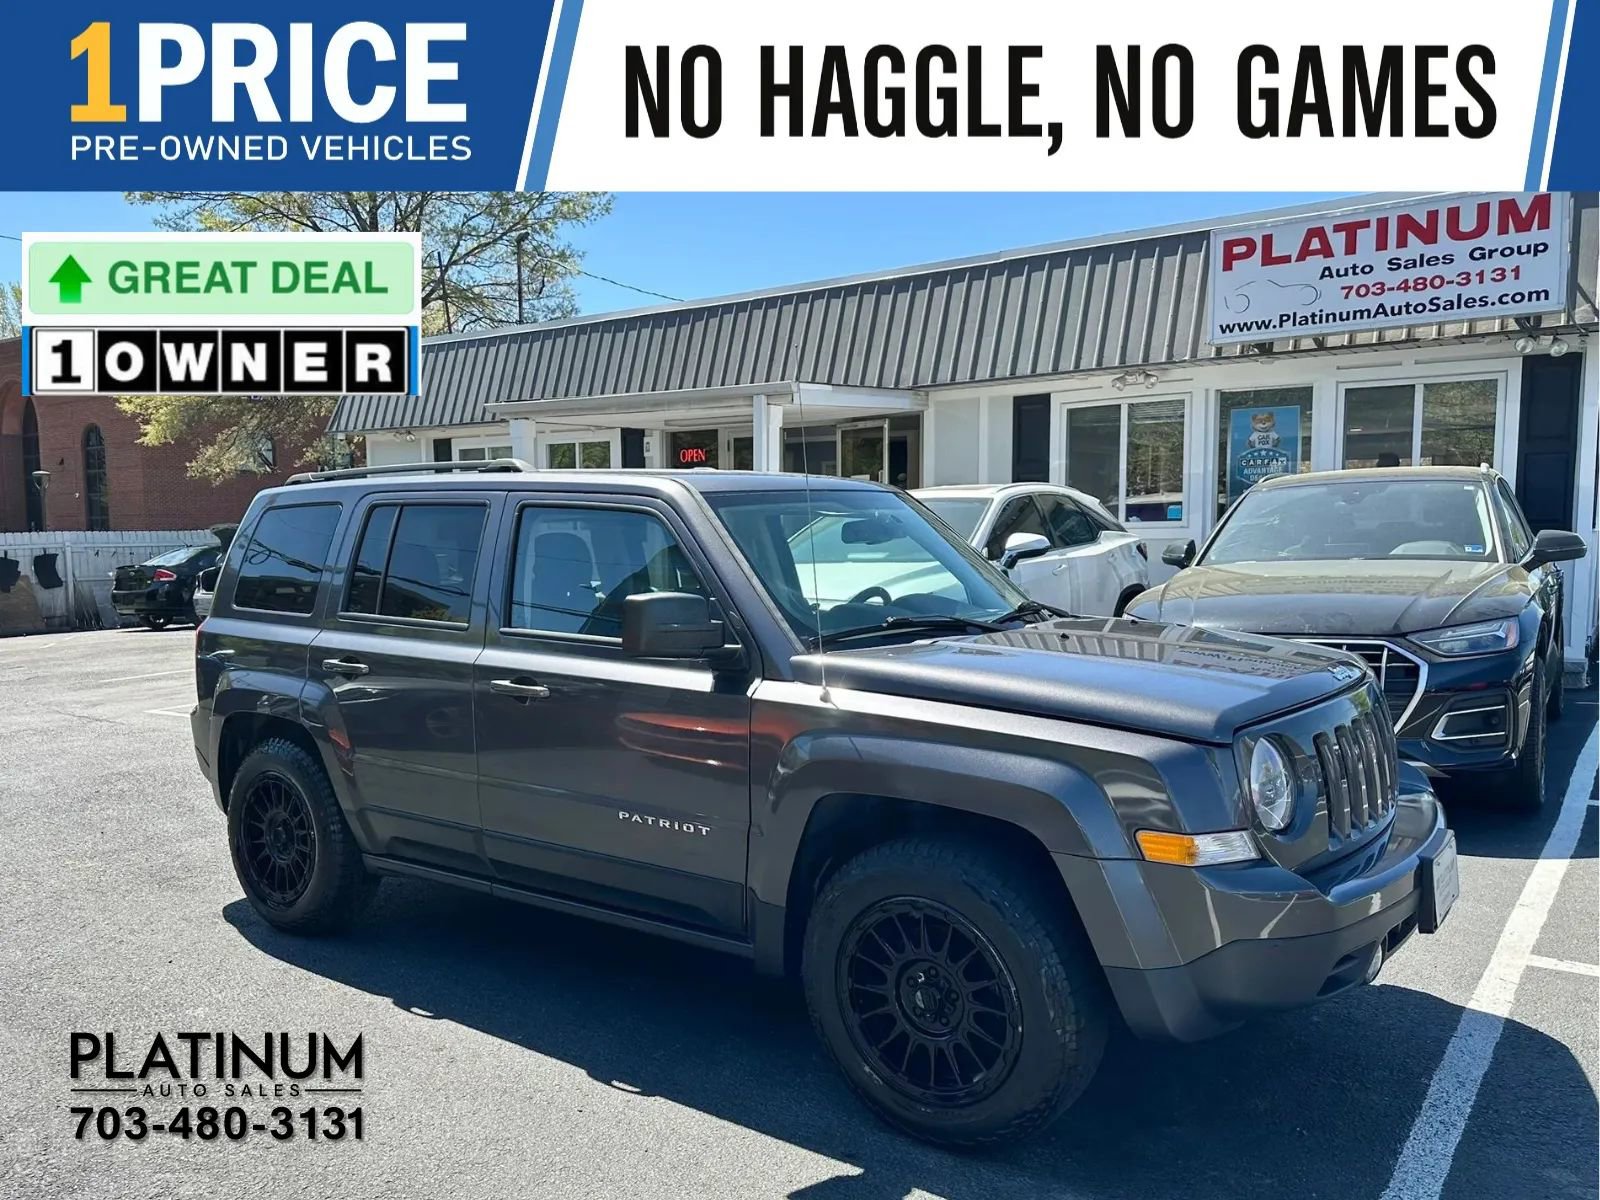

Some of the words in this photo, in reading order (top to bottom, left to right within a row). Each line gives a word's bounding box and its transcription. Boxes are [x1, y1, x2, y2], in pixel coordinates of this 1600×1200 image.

[1222, 193, 1551, 272] PLATINUM
[1319, 262, 1374, 280] Auto
[1387, 251, 1455, 272] Sales
[1468, 241, 1549, 262] Group
[1340, 265, 1522, 300] 703-480-3131
[1219, 287, 1550, 335] www.PlatinumAutoSales.com
[680, 448, 706, 463] OPEN
[618, 810, 711, 836] PATRIOT
